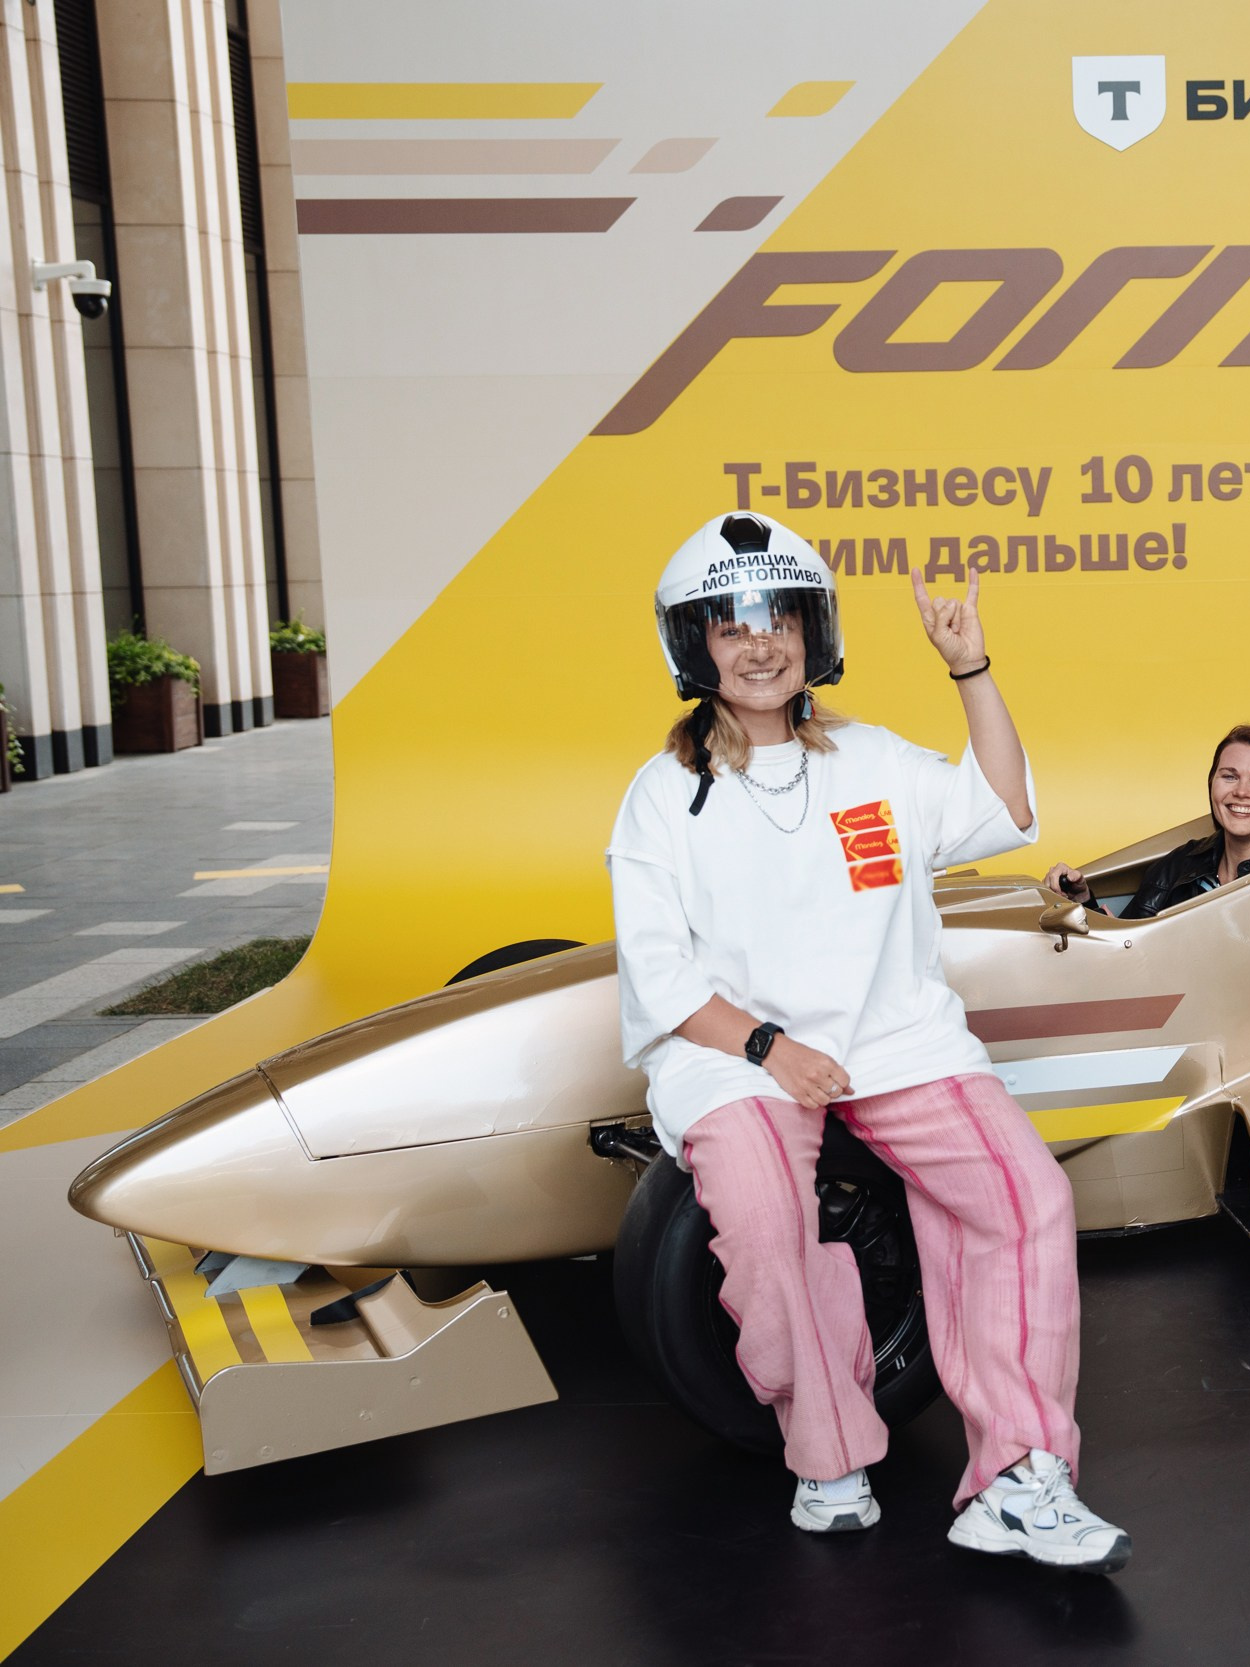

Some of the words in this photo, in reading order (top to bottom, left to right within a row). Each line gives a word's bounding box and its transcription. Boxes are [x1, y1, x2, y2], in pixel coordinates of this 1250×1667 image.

[723, 461, 1053, 518] Т-Бизнесу
[1080, 454, 1153, 504] 10
[707, 554, 799, 576] АМБИЦИИ
[924, 522, 1189, 584] дальше!
[702, 571, 741, 593] МОЕ
[747, 567, 823, 585] ТОПЛИВО
